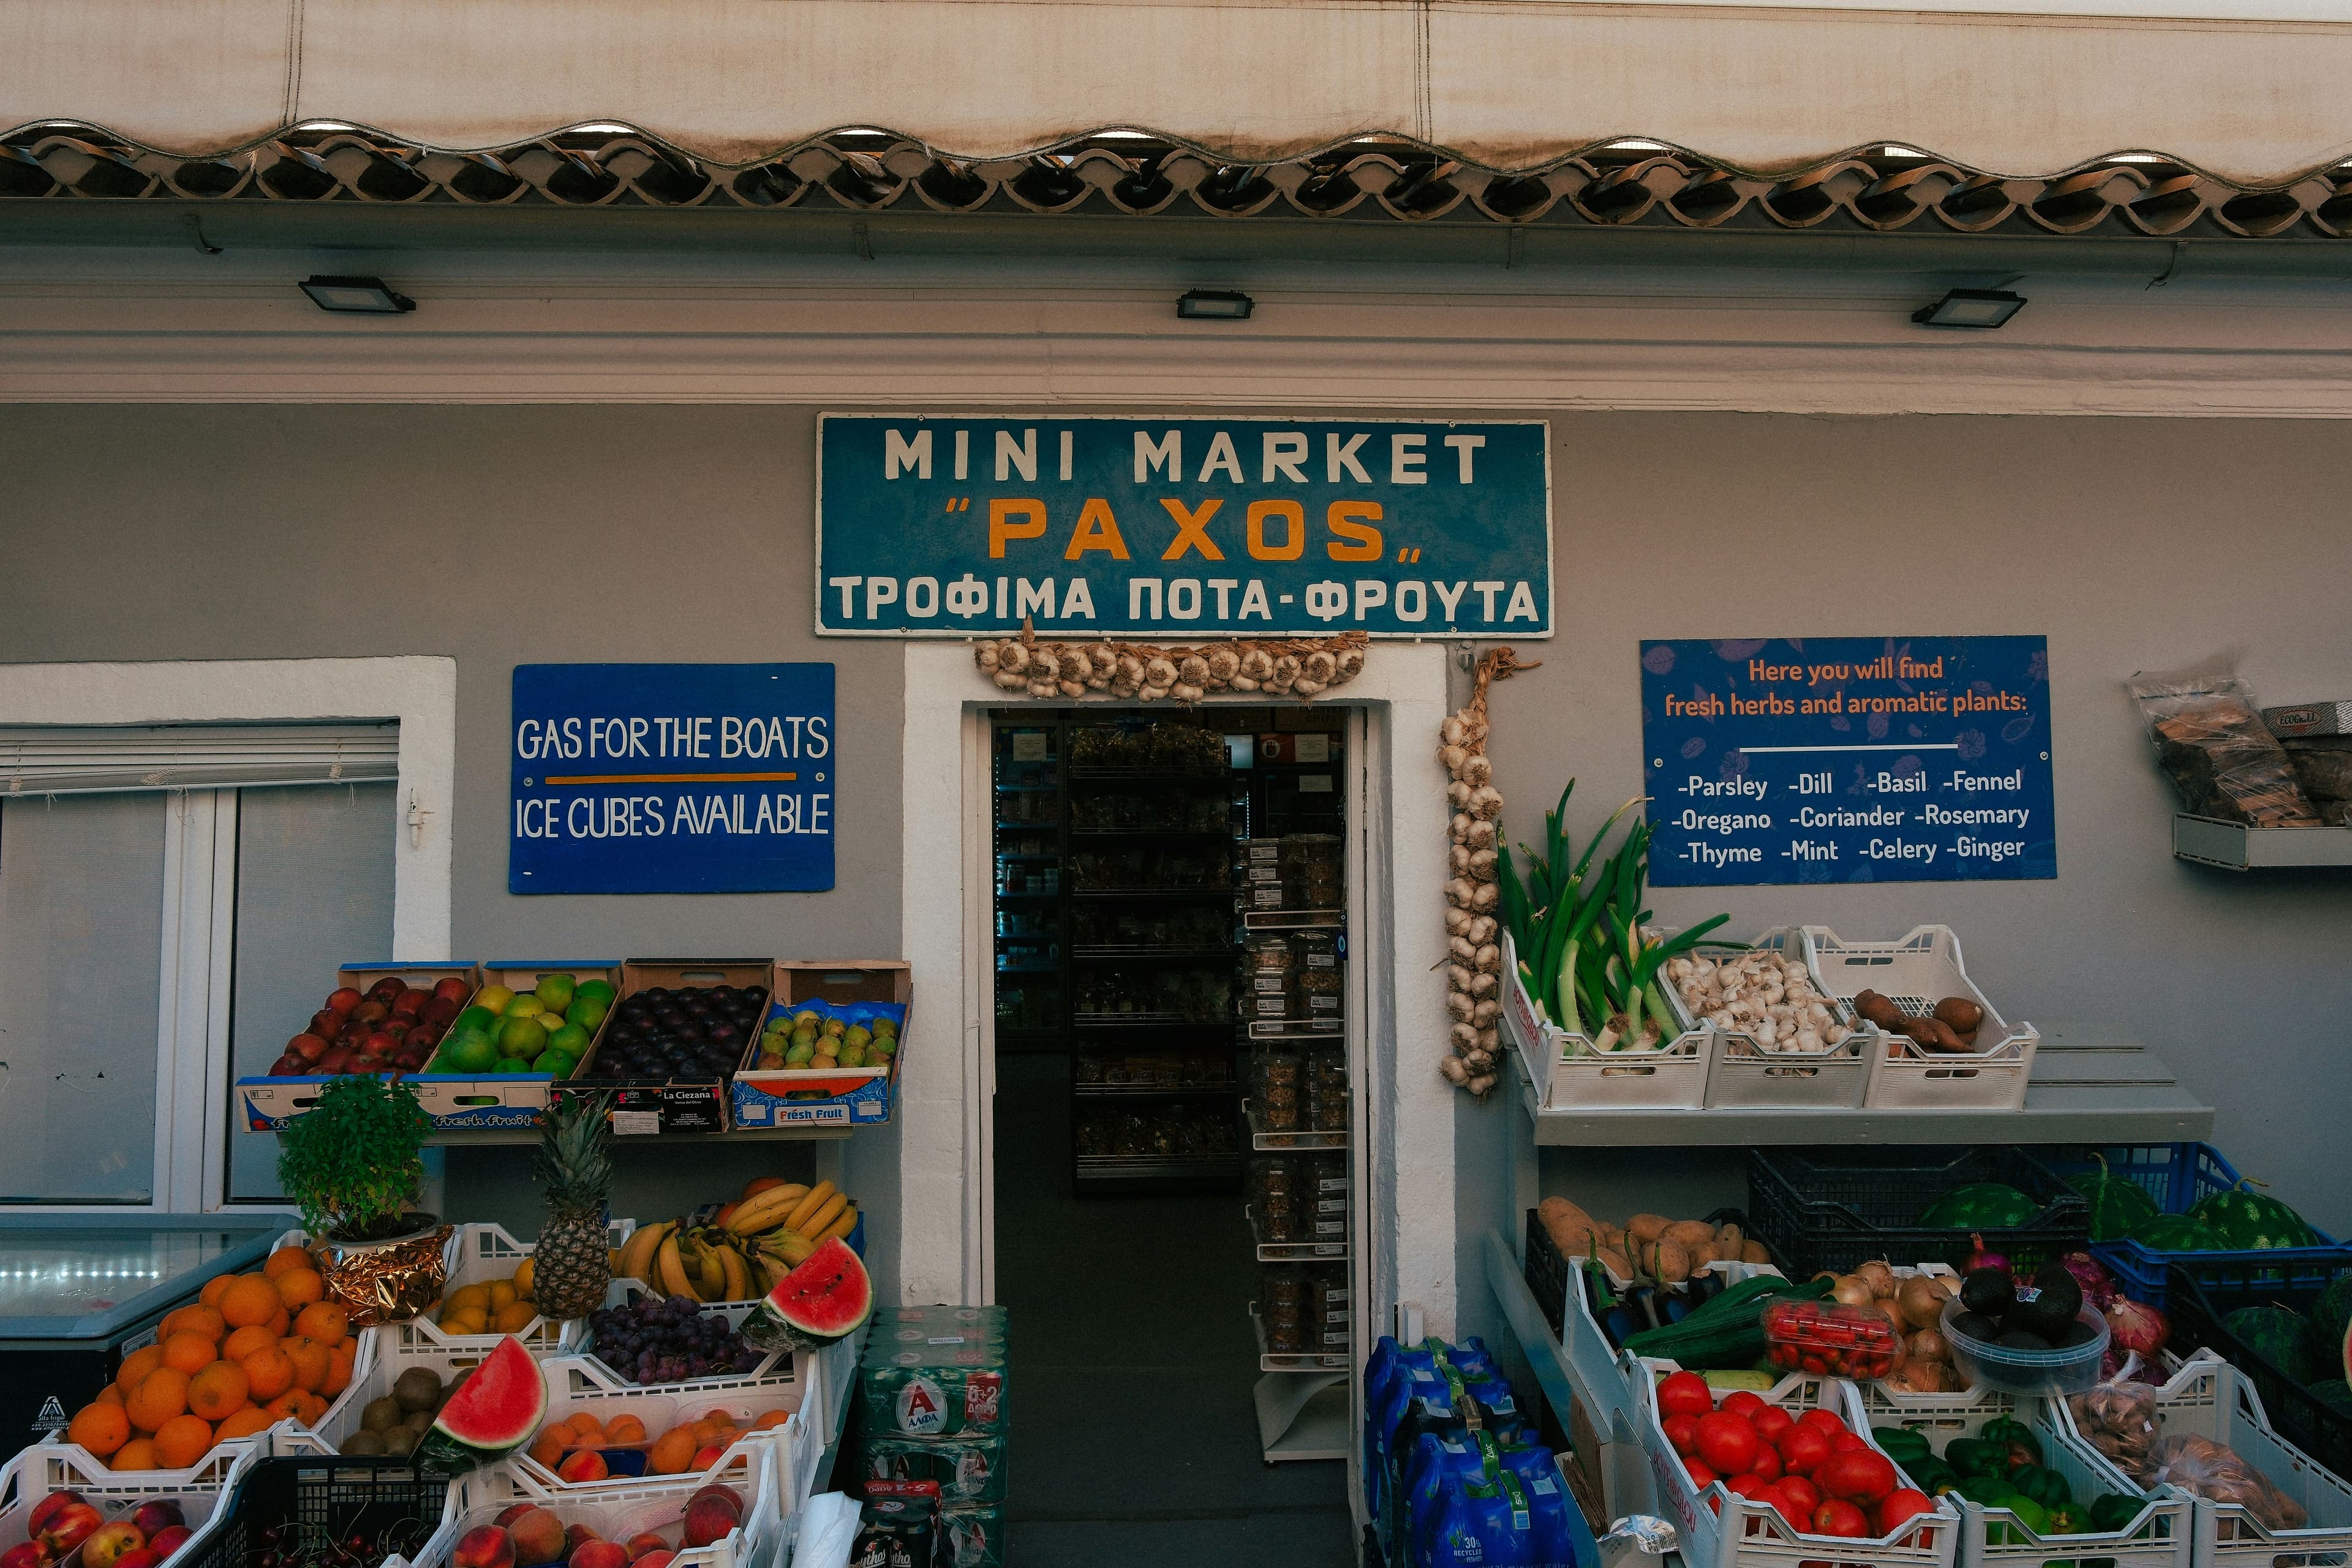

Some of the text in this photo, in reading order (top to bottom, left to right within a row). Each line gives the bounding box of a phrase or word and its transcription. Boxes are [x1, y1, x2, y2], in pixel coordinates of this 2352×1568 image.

[885, 428, 1486, 484] MINI MARKET
[829, 576, 1093, 620] ΤΡΟΦΙΜΑ
[1749, 656, 1943, 685] Here you will find
[1665, 689, 2027, 717] fresh herbs and aromatic plants:
[518, 716, 829, 759] GAS FOR THE BOATS
[1678, 769, 2021, 801] -Parsley -Dill -Basil -Fennel
[516, 794, 830, 839] ICE CUBES AVAILABLE
[1672, 804, 2030, 835] -Oregano -Coriander -Rosemary
[1679, 836, 2026, 869] -Thyme -Mint -Celery -Ginger
[435, 1114, 533, 1127] fresh fruit
[856, 1549, 886, 1567] ythos
[1464, 1536, 1482, 1549] 30%
